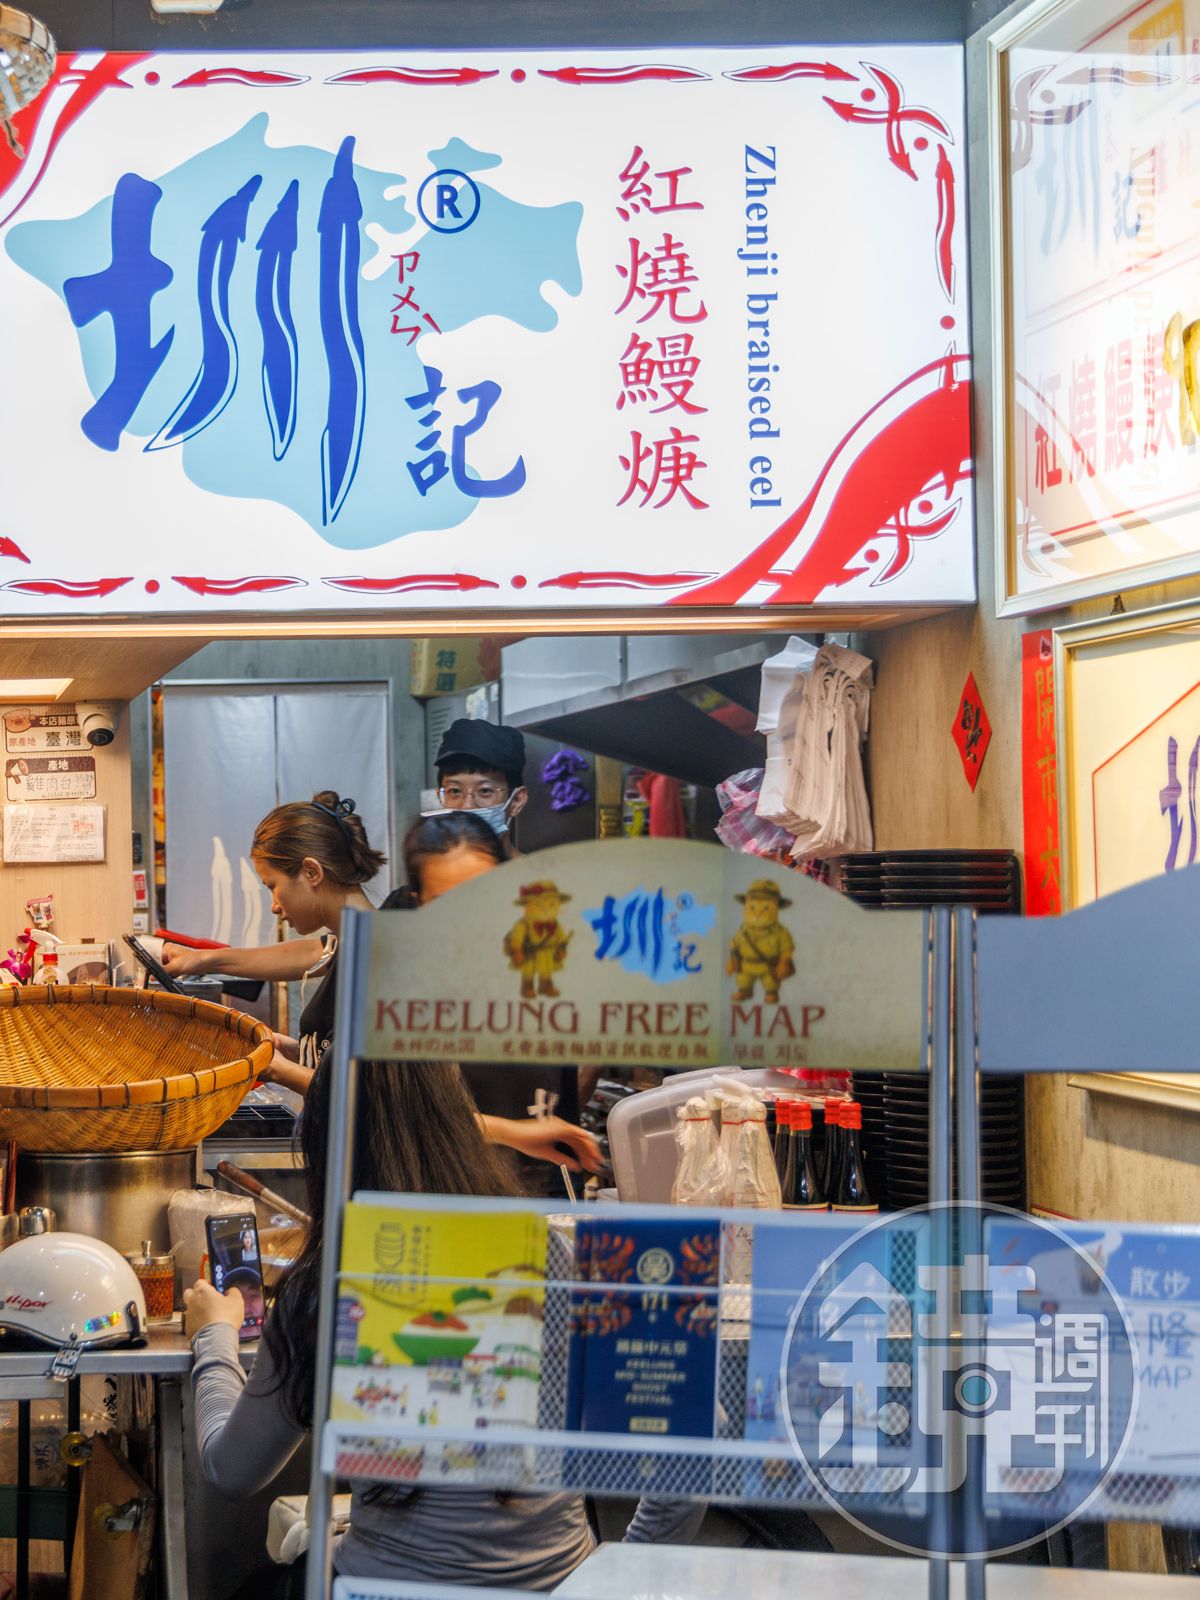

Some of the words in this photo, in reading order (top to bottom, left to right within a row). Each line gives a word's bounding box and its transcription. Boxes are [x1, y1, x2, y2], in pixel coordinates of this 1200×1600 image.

[738, 145, 777, 276] Zhenji
[614, 145, 709, 511] 紅燒鰻焿
[747, 292, 779, 439] braised
[750, 455, 781, 509] eel
[39, 716, 79, 726] 本店豬原
[45, 731, 82, 747] 臺灣
[47, 759, 69, 771] 產地
[1035, 664, 1062, 914] 開市大
[375, 1000, 579, 1034] KEELUNG
[600, 1002, 709, 1036] FREE
[730, 1004, 826, 1039] MAP
[1130, 1266, 1191, 1298] 散步
